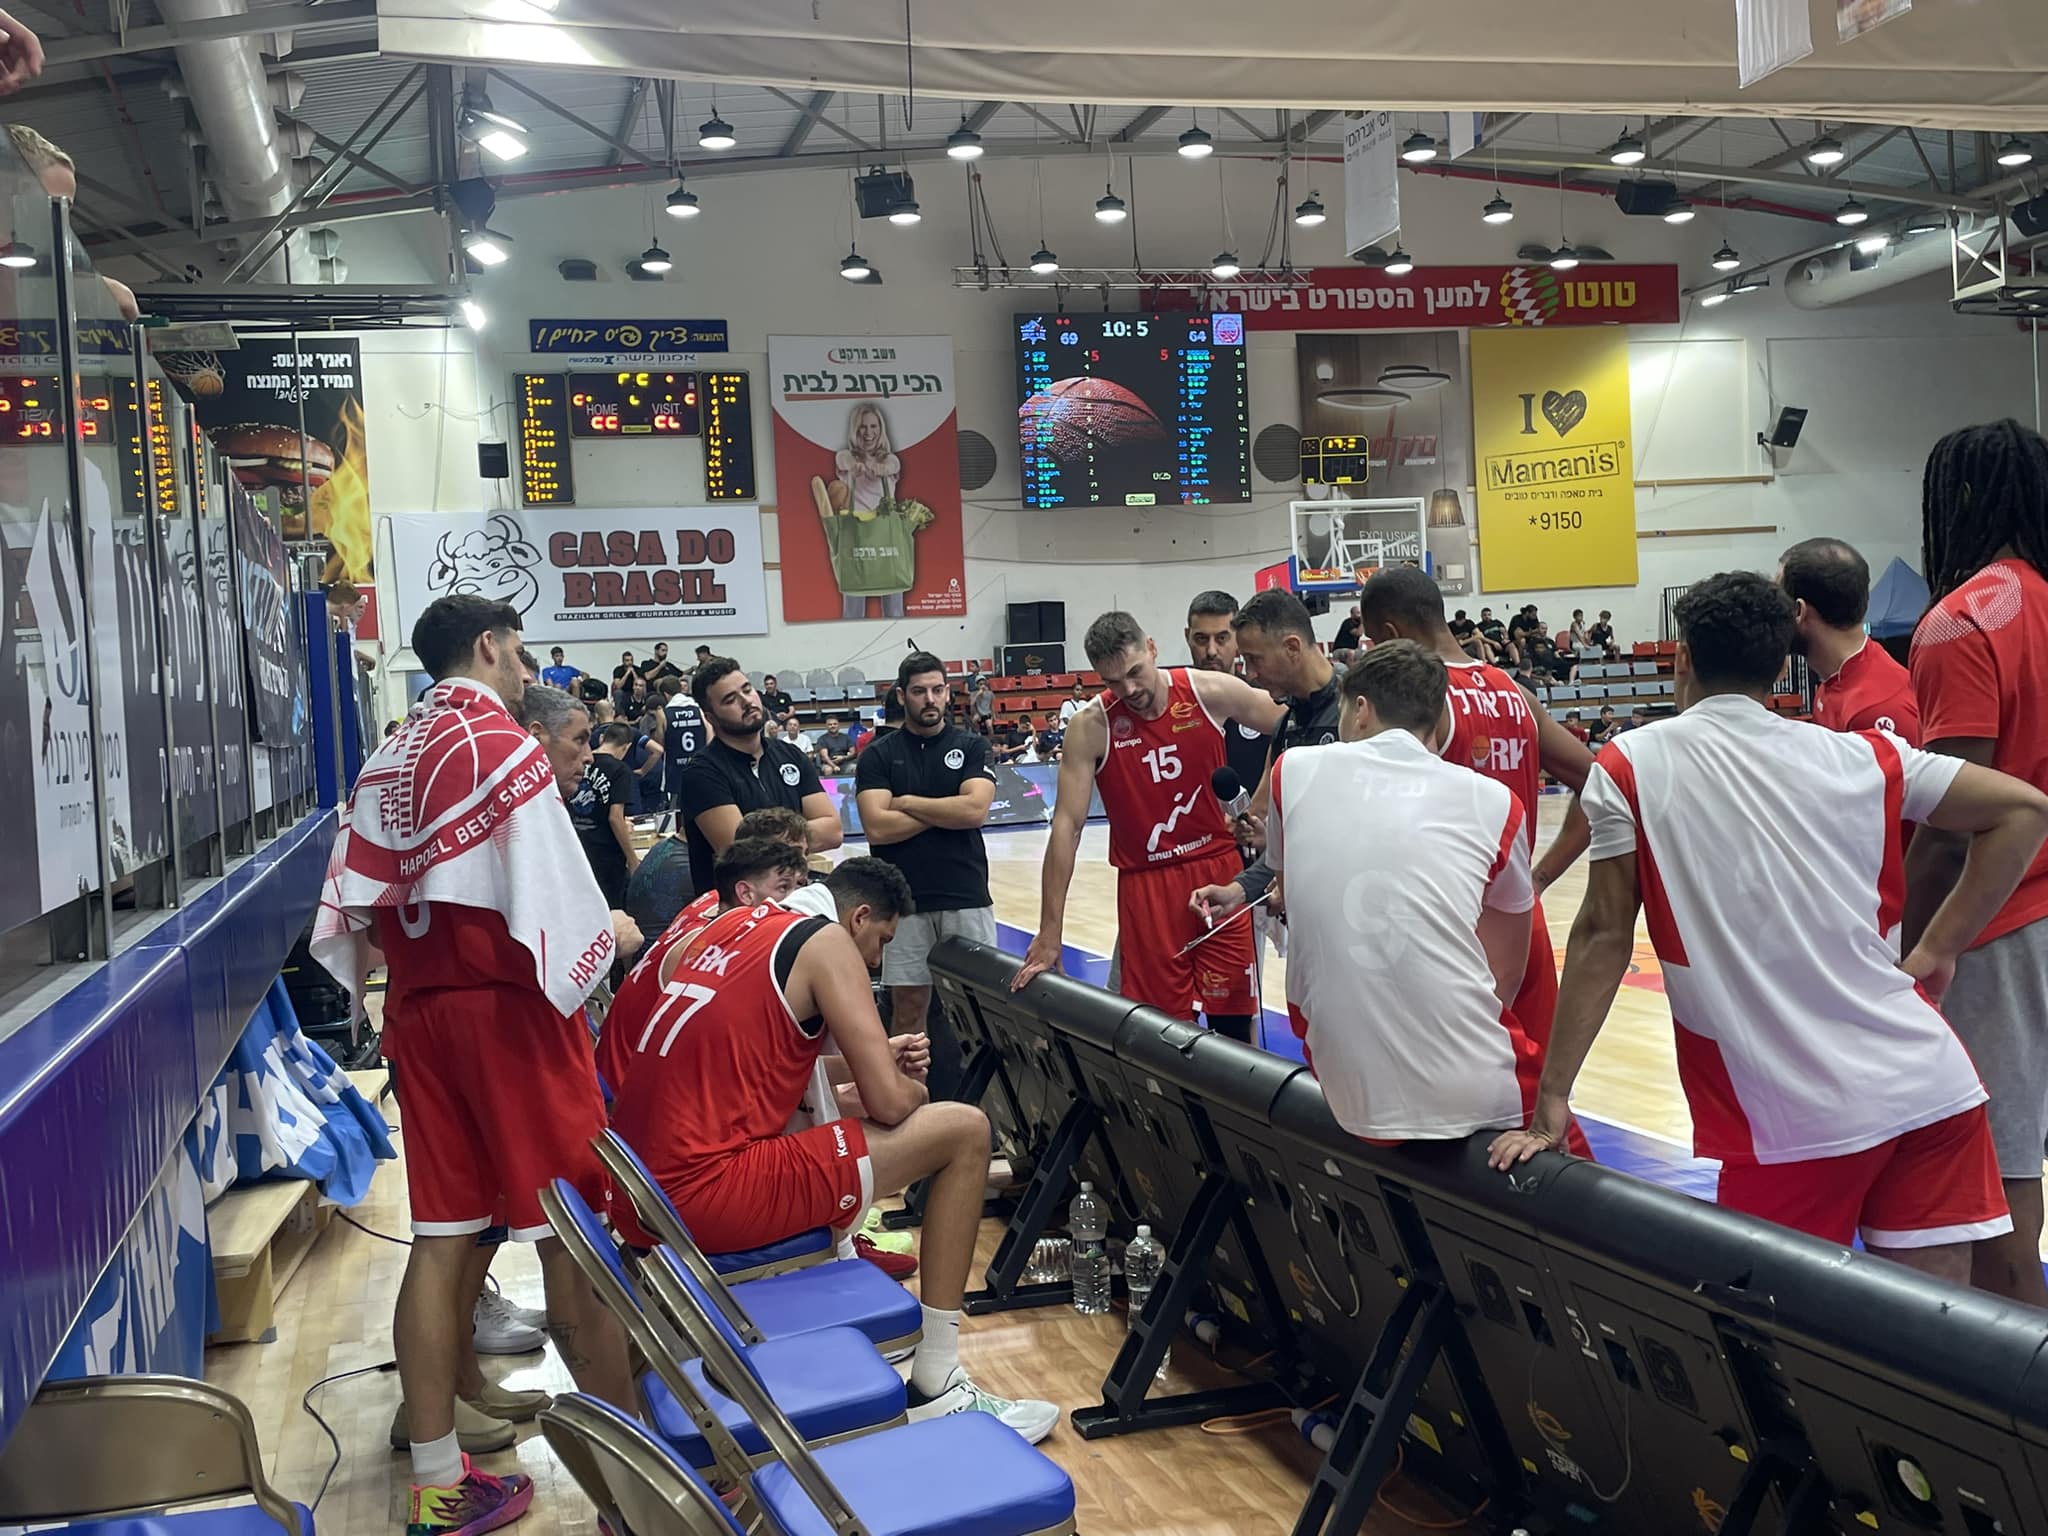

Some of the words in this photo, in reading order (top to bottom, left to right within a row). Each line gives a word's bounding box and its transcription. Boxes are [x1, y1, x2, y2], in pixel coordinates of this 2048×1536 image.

[1308, 286, 1415, 310] הספורט
[1425, 279, 1491, 315] למען
[1563, 279, 1637, 309] טוטו
[605, 325, 643, 347] פיס
[649, 326, 688, 352] צריך
[1059, 332, 1079, 345] 69
[1188, 330, 1207, 343] 64
[838, 348, 868, 361] מרקט
[246, 374, 291, 389] המנצח
[320, 374, 354, 389] תמיד
[783, 370, 838, 393] לבית
[843, 373, 898, 399] קרוב
[903, 373, 942, 393] הכי
[586, 403, 619, 416] HOME
[1518, 393, 1538, 435] I
[1489, 444, 1615, 488] Mamani's
[1588, 488, 1603, 498] בית
[1359, 530, 1420, 542] EXCLUSIVE
[549, 530, 668, 569] CASA
[676, 528, 735, 566] DO
[563, 568, 727, 608] BRASIL
[556, 612, 600, 621] BRAZILIAN
[602, 611, 627, 620] GRILL
[635, 609, 698, 619] CHURRASCARIA
[708, 608, 735, 616] MUSIC
[681, 731, 695, 753] 6
[1113, 736, 1142, 750] Kempa
[1141, 743, 1183, 784] 15
[400, 836, 453, 877] HAPOEL
[455, 806, 499, 846] BEER
[498, 753, 550, 808] SHEVA
[568, 928, 615, 990] HAPOEL
[637, 980, 717, 1057] 77
